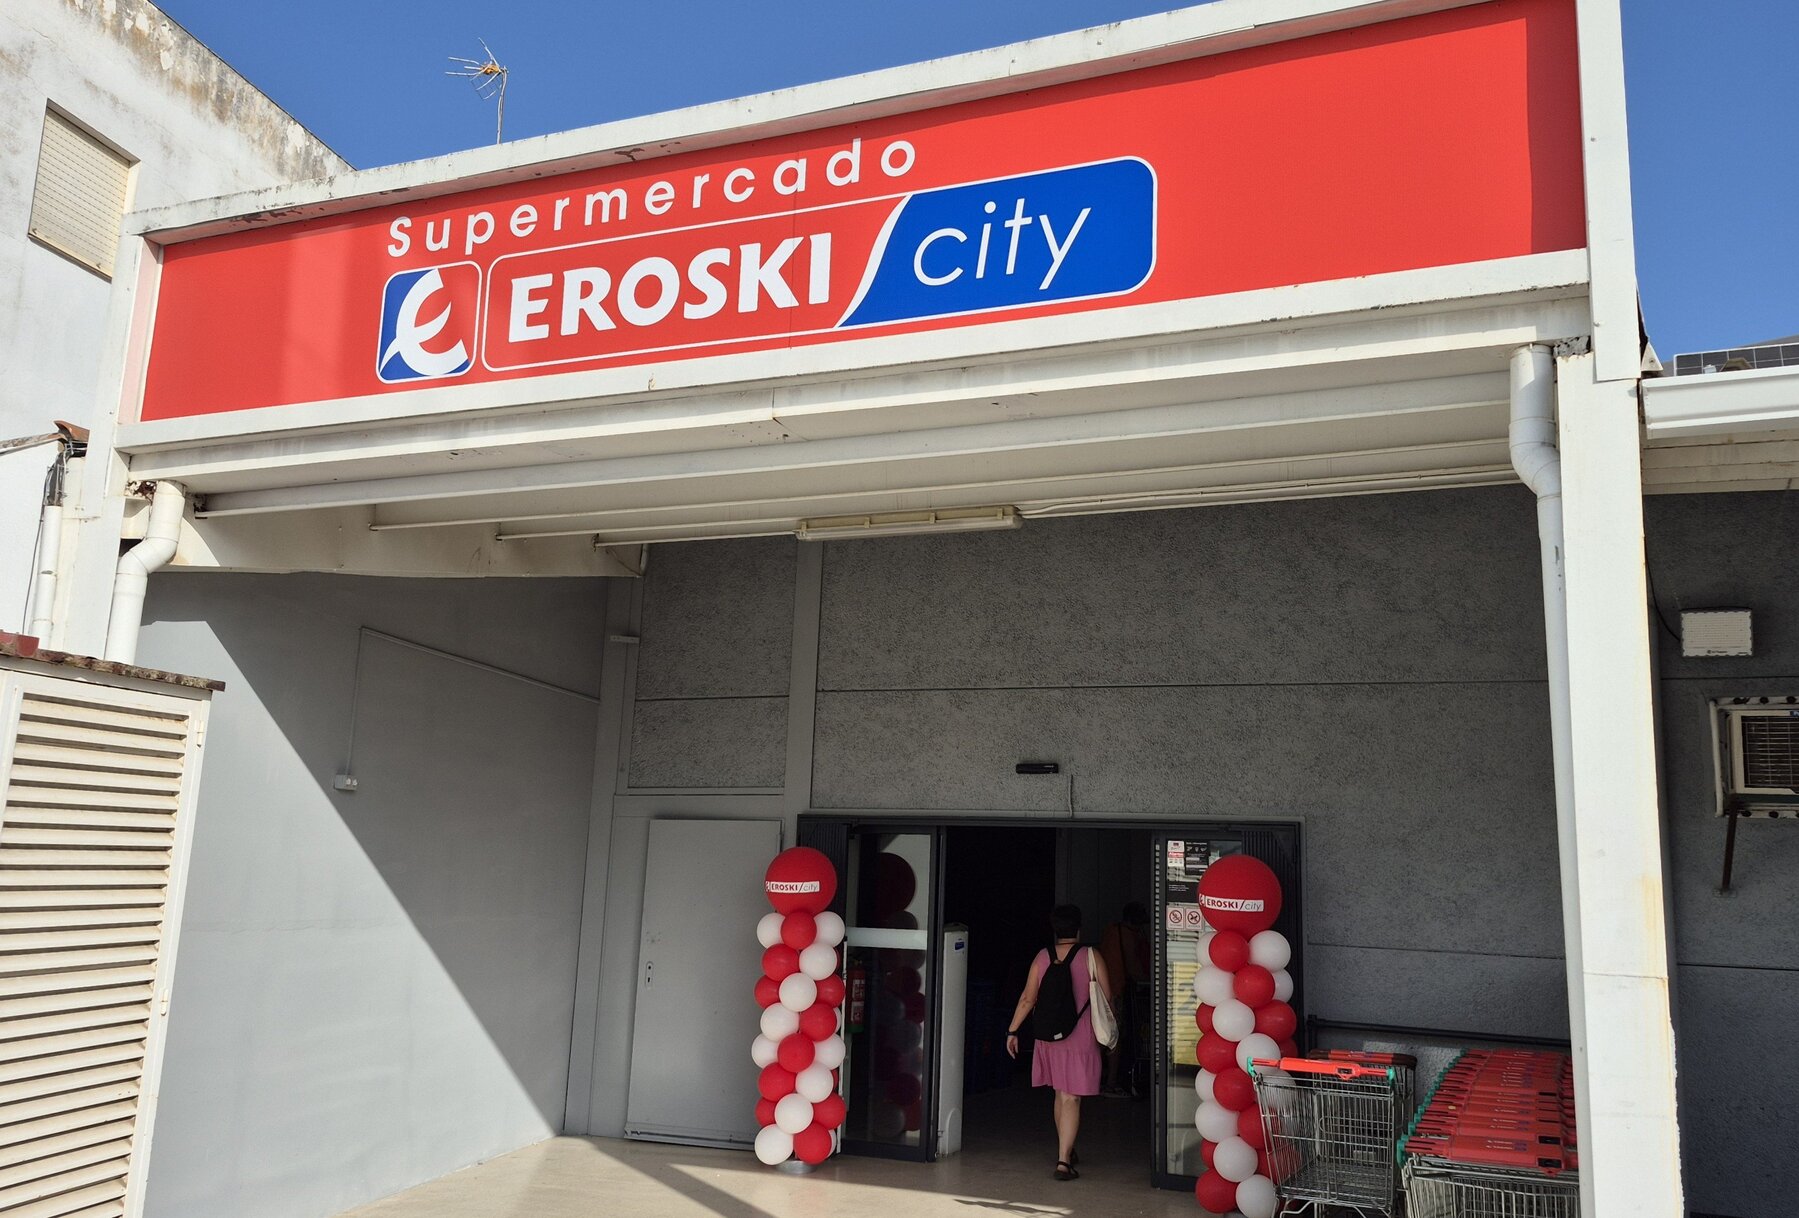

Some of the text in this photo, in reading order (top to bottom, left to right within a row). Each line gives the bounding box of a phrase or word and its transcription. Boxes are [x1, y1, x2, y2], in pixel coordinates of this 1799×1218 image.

[386, 138, 917, 259] Supermercado
[508, 232, 832, 343] EROSKI
[913, 198, 1092, 291] city
[1206, 898, 1239, 909] EROSKI
